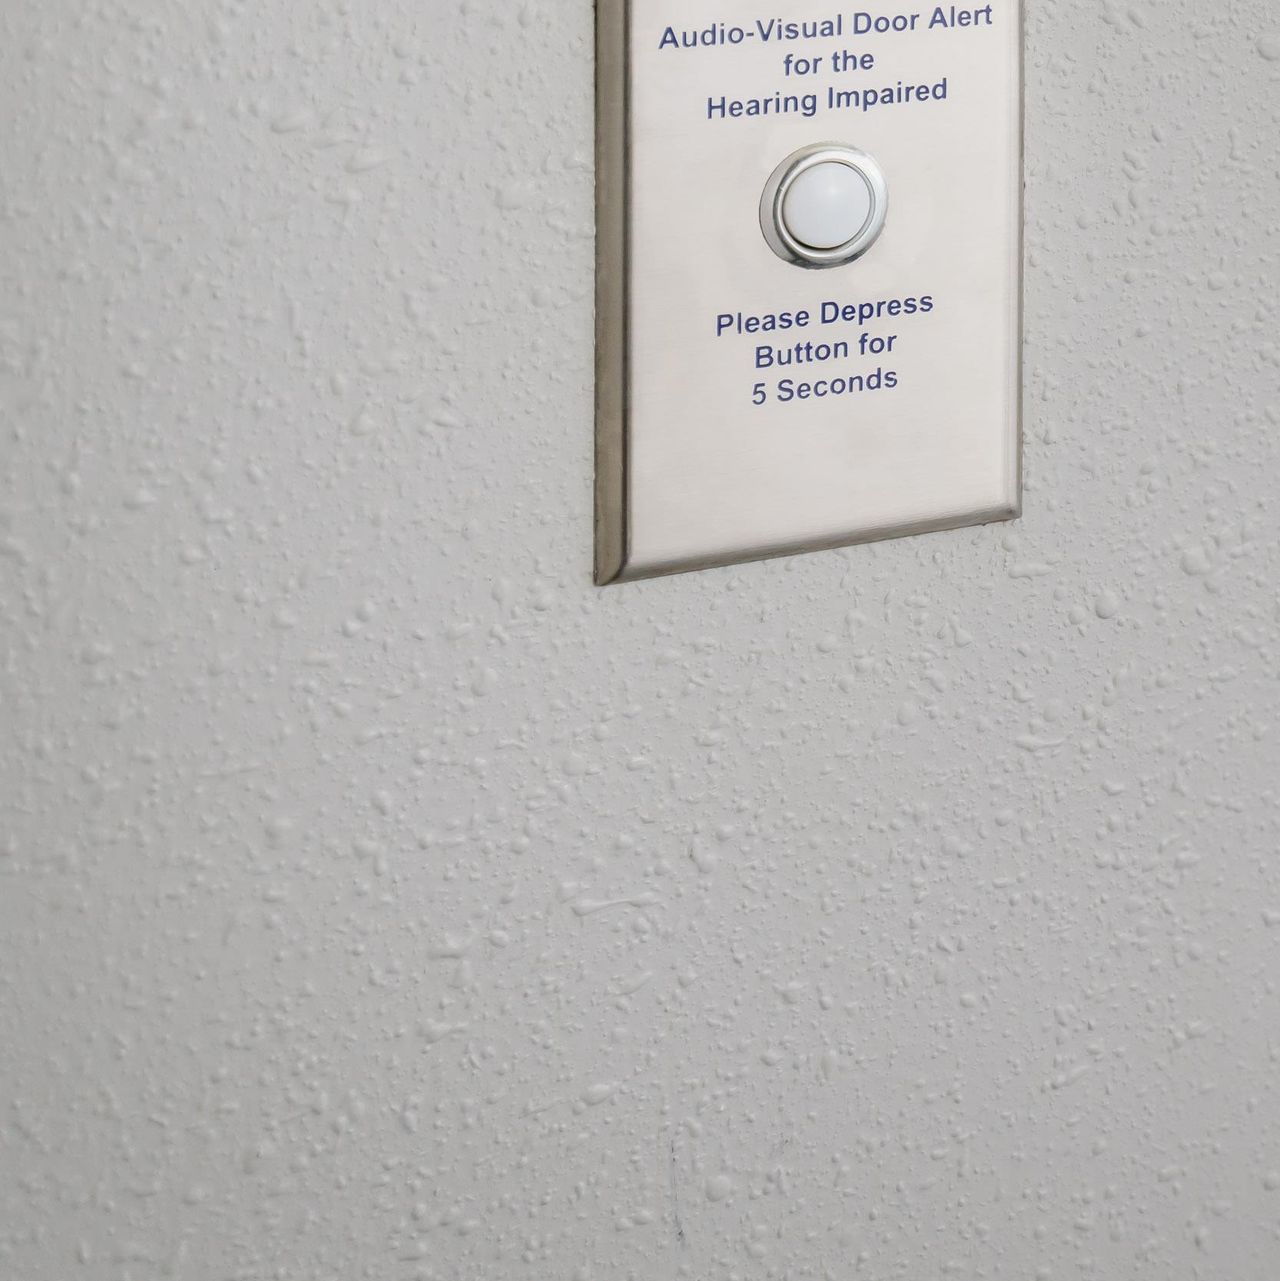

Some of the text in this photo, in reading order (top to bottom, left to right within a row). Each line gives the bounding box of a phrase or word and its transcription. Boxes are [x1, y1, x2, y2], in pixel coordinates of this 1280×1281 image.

[658, 4, 993, 49] Audio-Visual Door Alert
[783, 49, 875, 77] for the
[707, 78, 948, 119] Hearing Impaired
[716, 295, 934, 337] Please Depress
[755, 332, 898, 369] Button for
[752, 367, 899, 406] 5 Seconds
